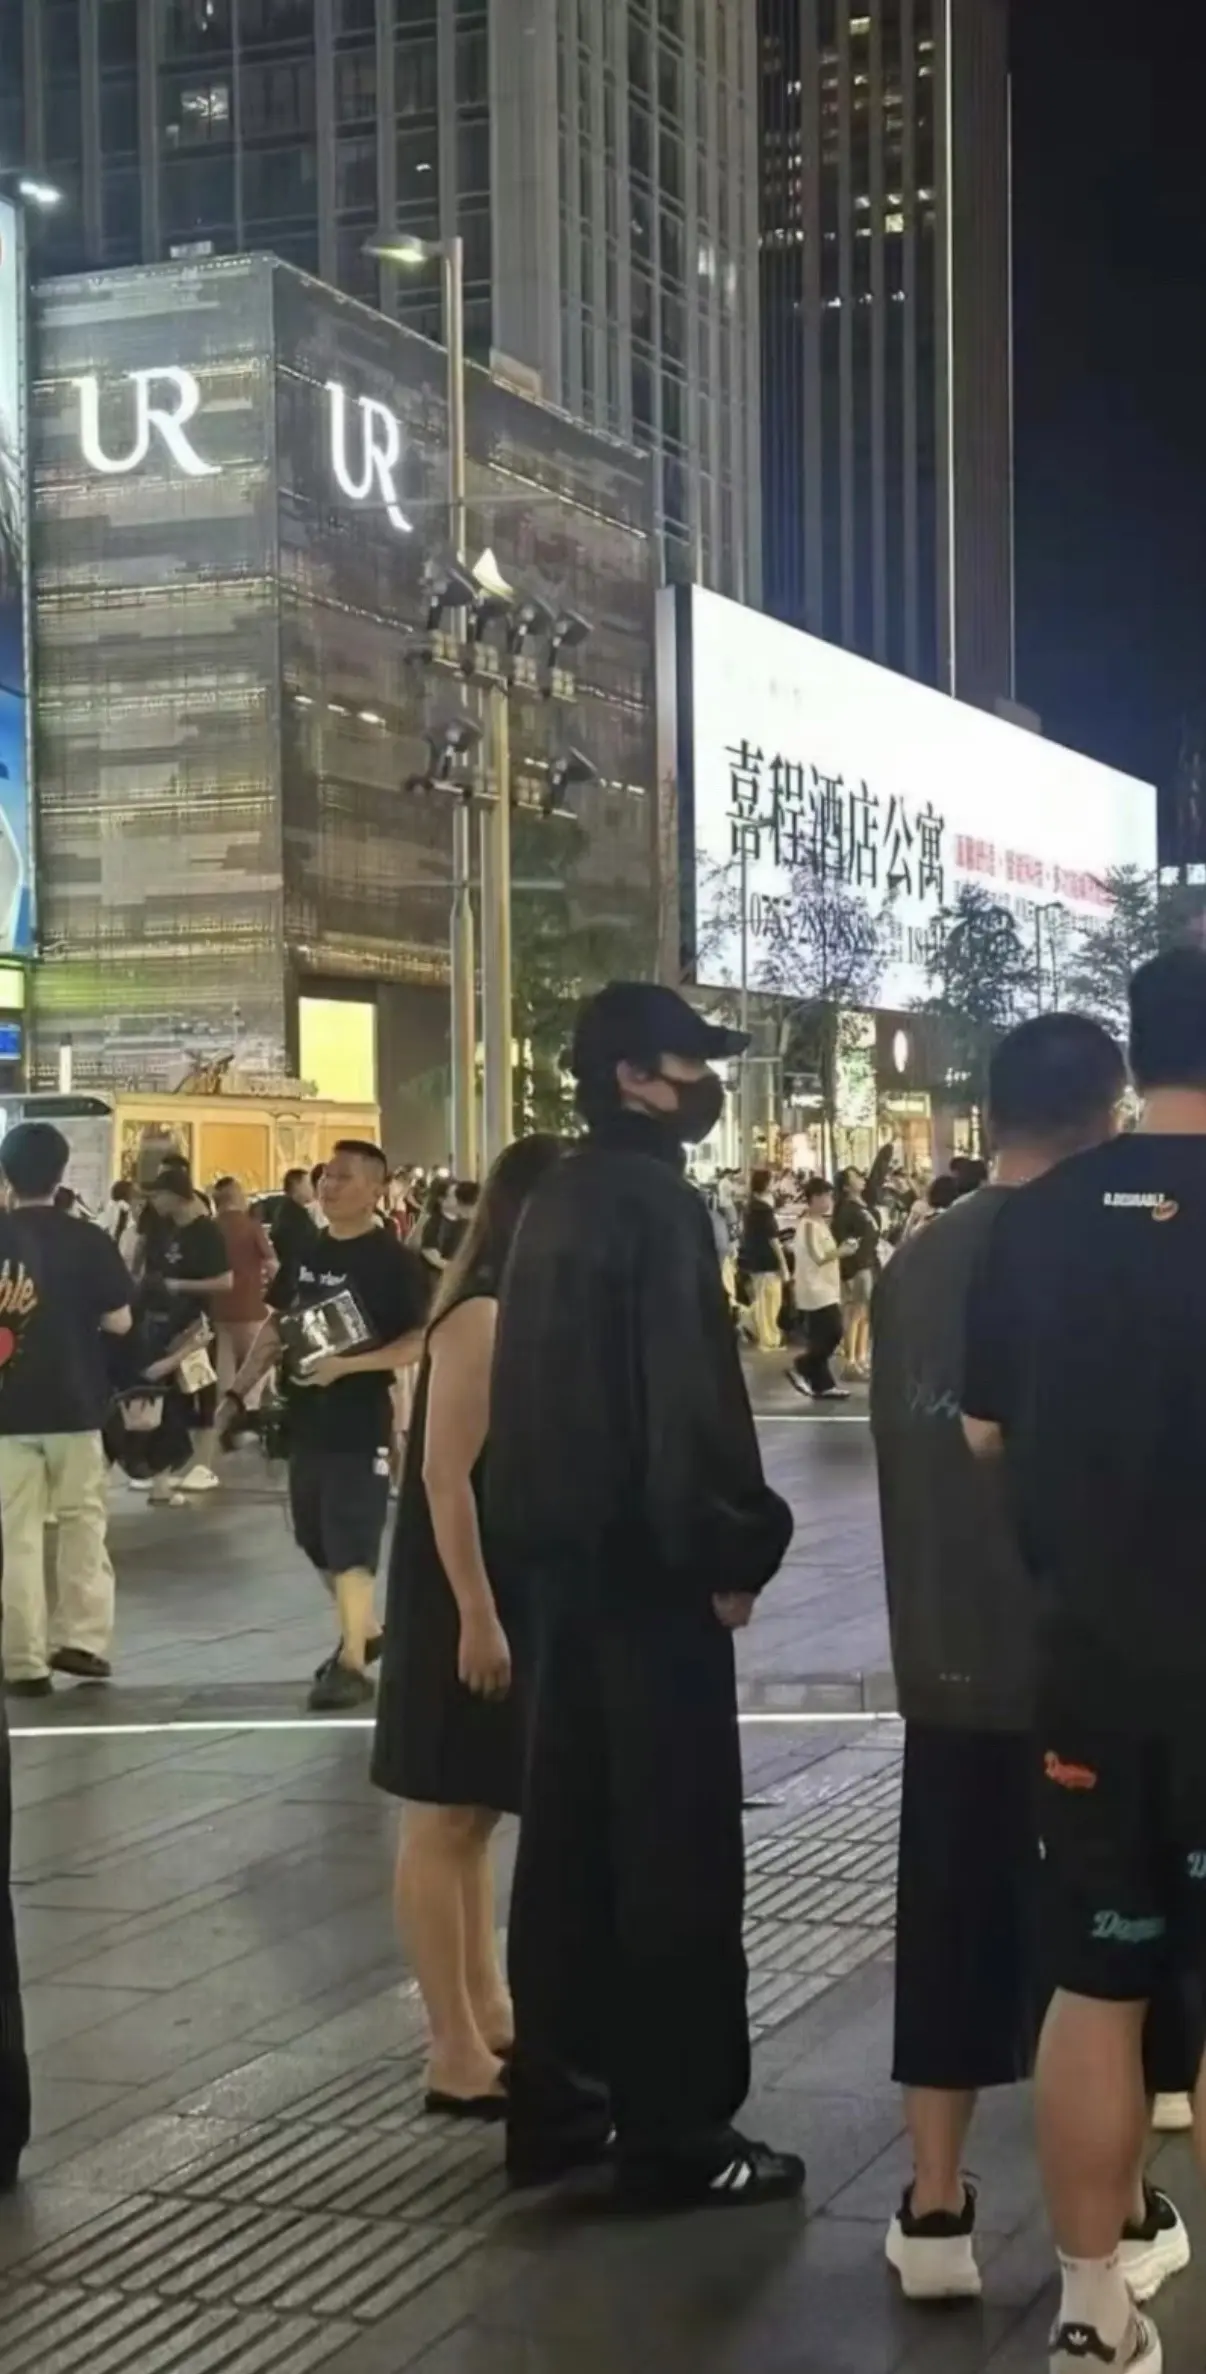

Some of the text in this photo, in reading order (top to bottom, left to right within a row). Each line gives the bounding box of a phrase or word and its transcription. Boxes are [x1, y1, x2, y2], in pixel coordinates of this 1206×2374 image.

[72, 366, 221, 476] UR
[326, 381, 413, 532] UR
[724, 738, 945, 906] 喜程酒店公寓
